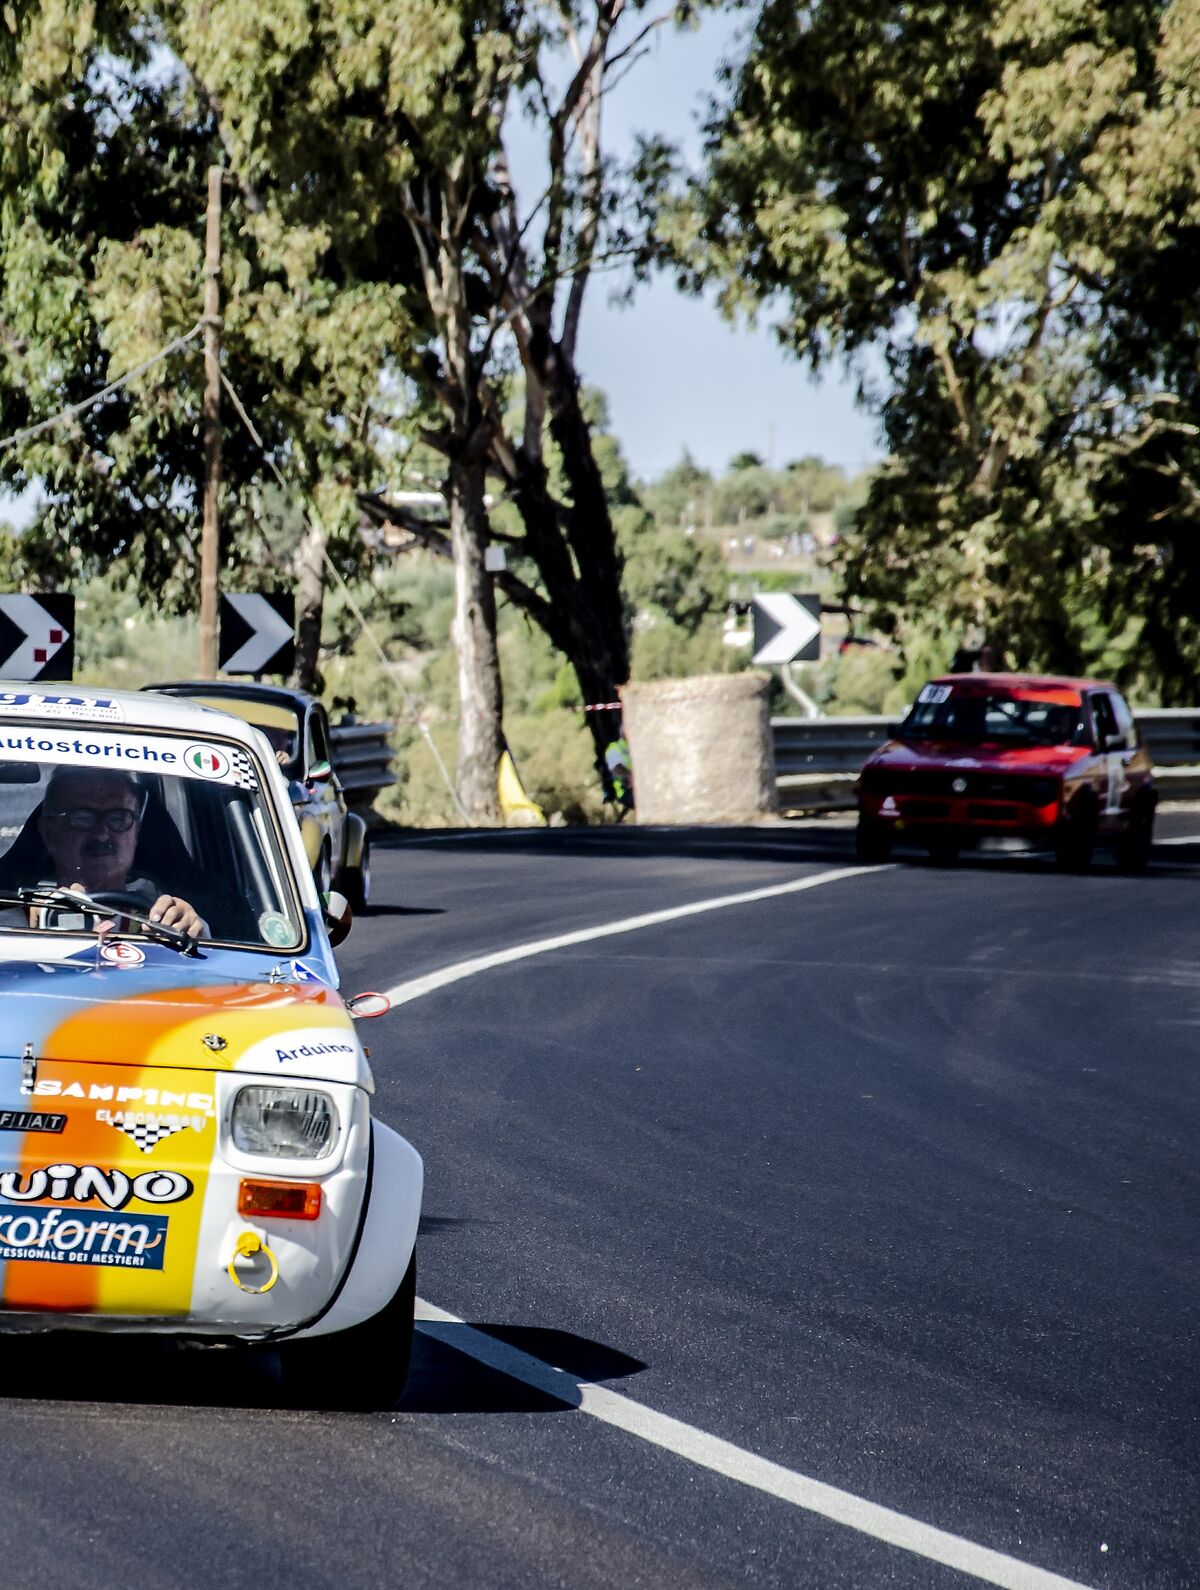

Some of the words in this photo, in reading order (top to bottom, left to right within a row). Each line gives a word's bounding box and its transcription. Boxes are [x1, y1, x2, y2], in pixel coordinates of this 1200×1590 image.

[275, 1043, 354, 1063] Arduino
[0, 1112, 62, 1130] FIAT
[68, 1252, 88, 1263] DEI
[92, 1254, 145, 1267] MESTIERI
